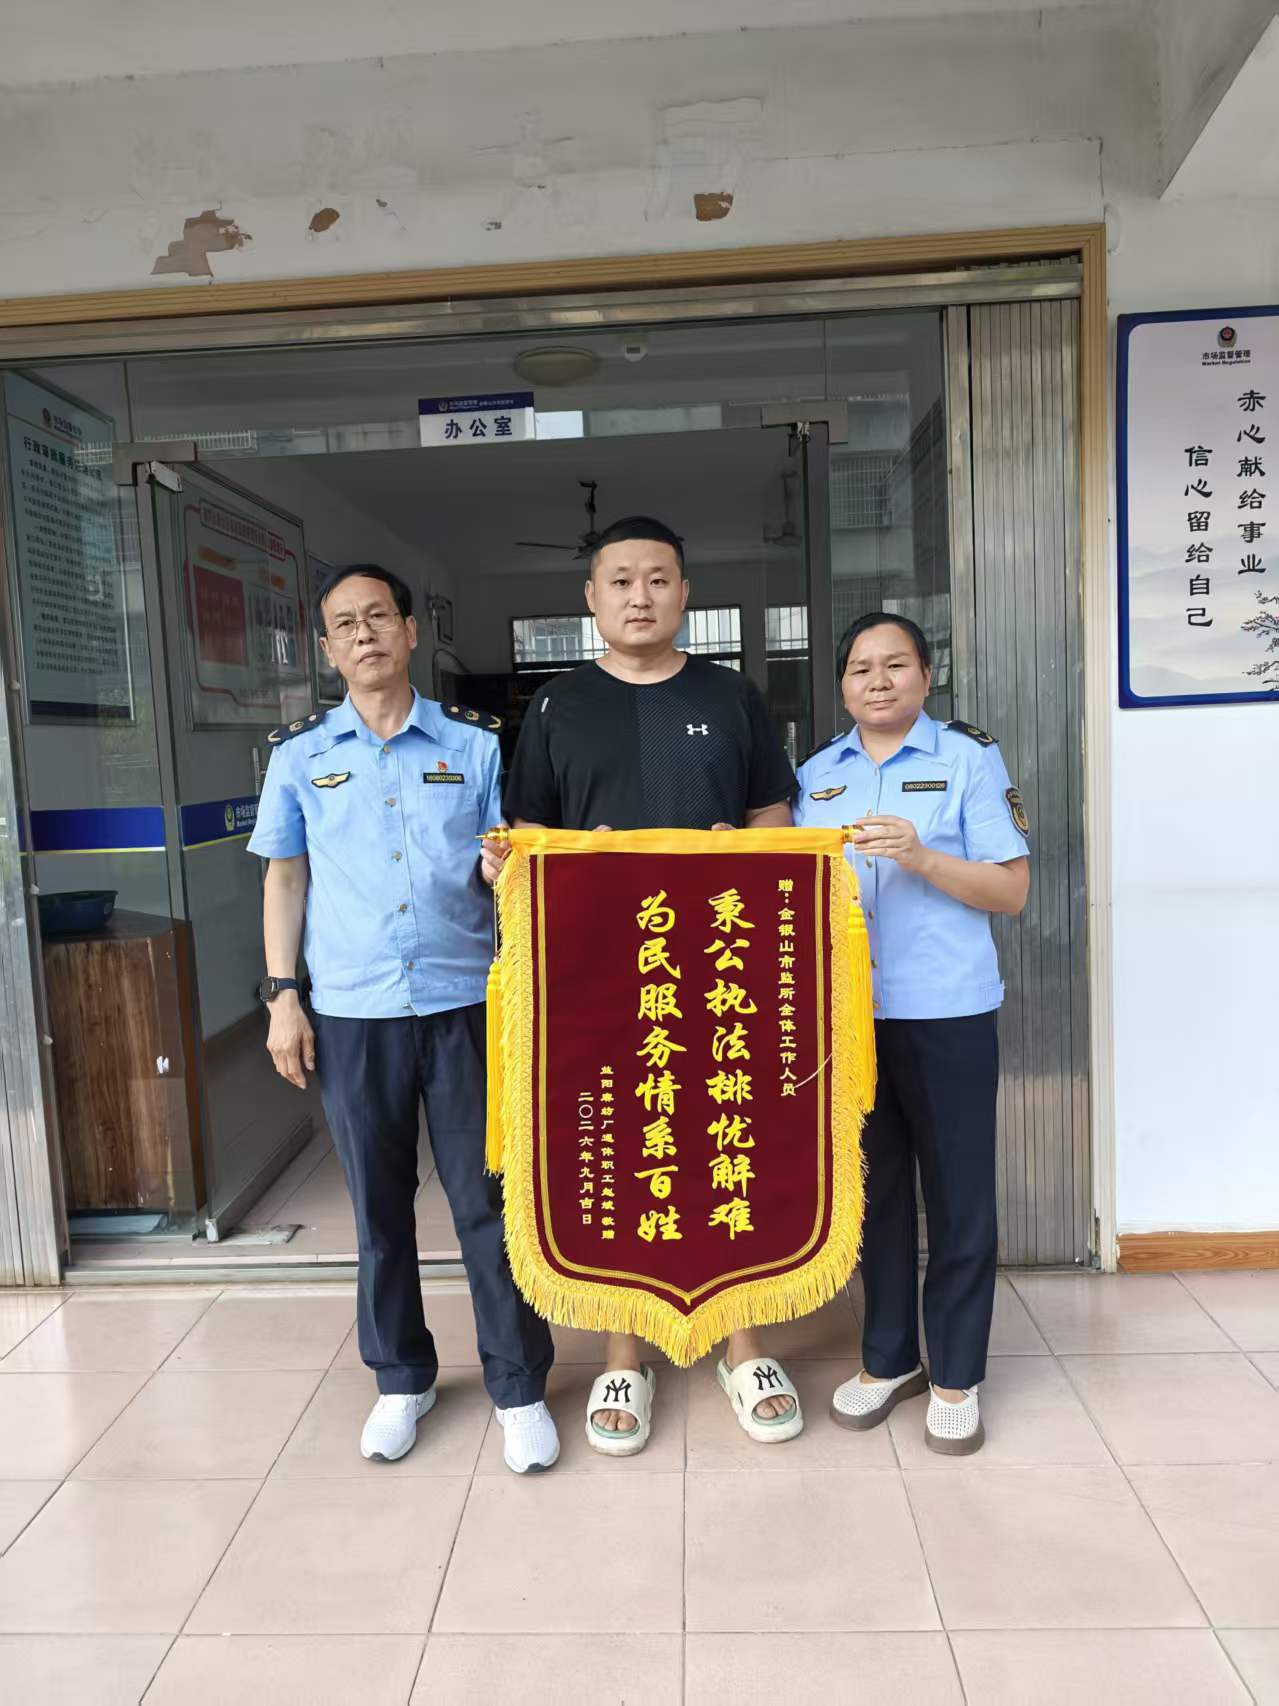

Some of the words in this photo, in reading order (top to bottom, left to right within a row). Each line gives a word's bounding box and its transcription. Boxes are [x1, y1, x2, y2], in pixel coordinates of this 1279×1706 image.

[445, 416, 512, 439] 办公室
[1237, 390, 1266, 574] 赤心献给事业
[1185, 446, 1212, 626] 信心留给自己
[634, 890, 687, 1242] 为民服务情系百姓
[704, 888, 757, 1240] 秉公执法排忧解难
